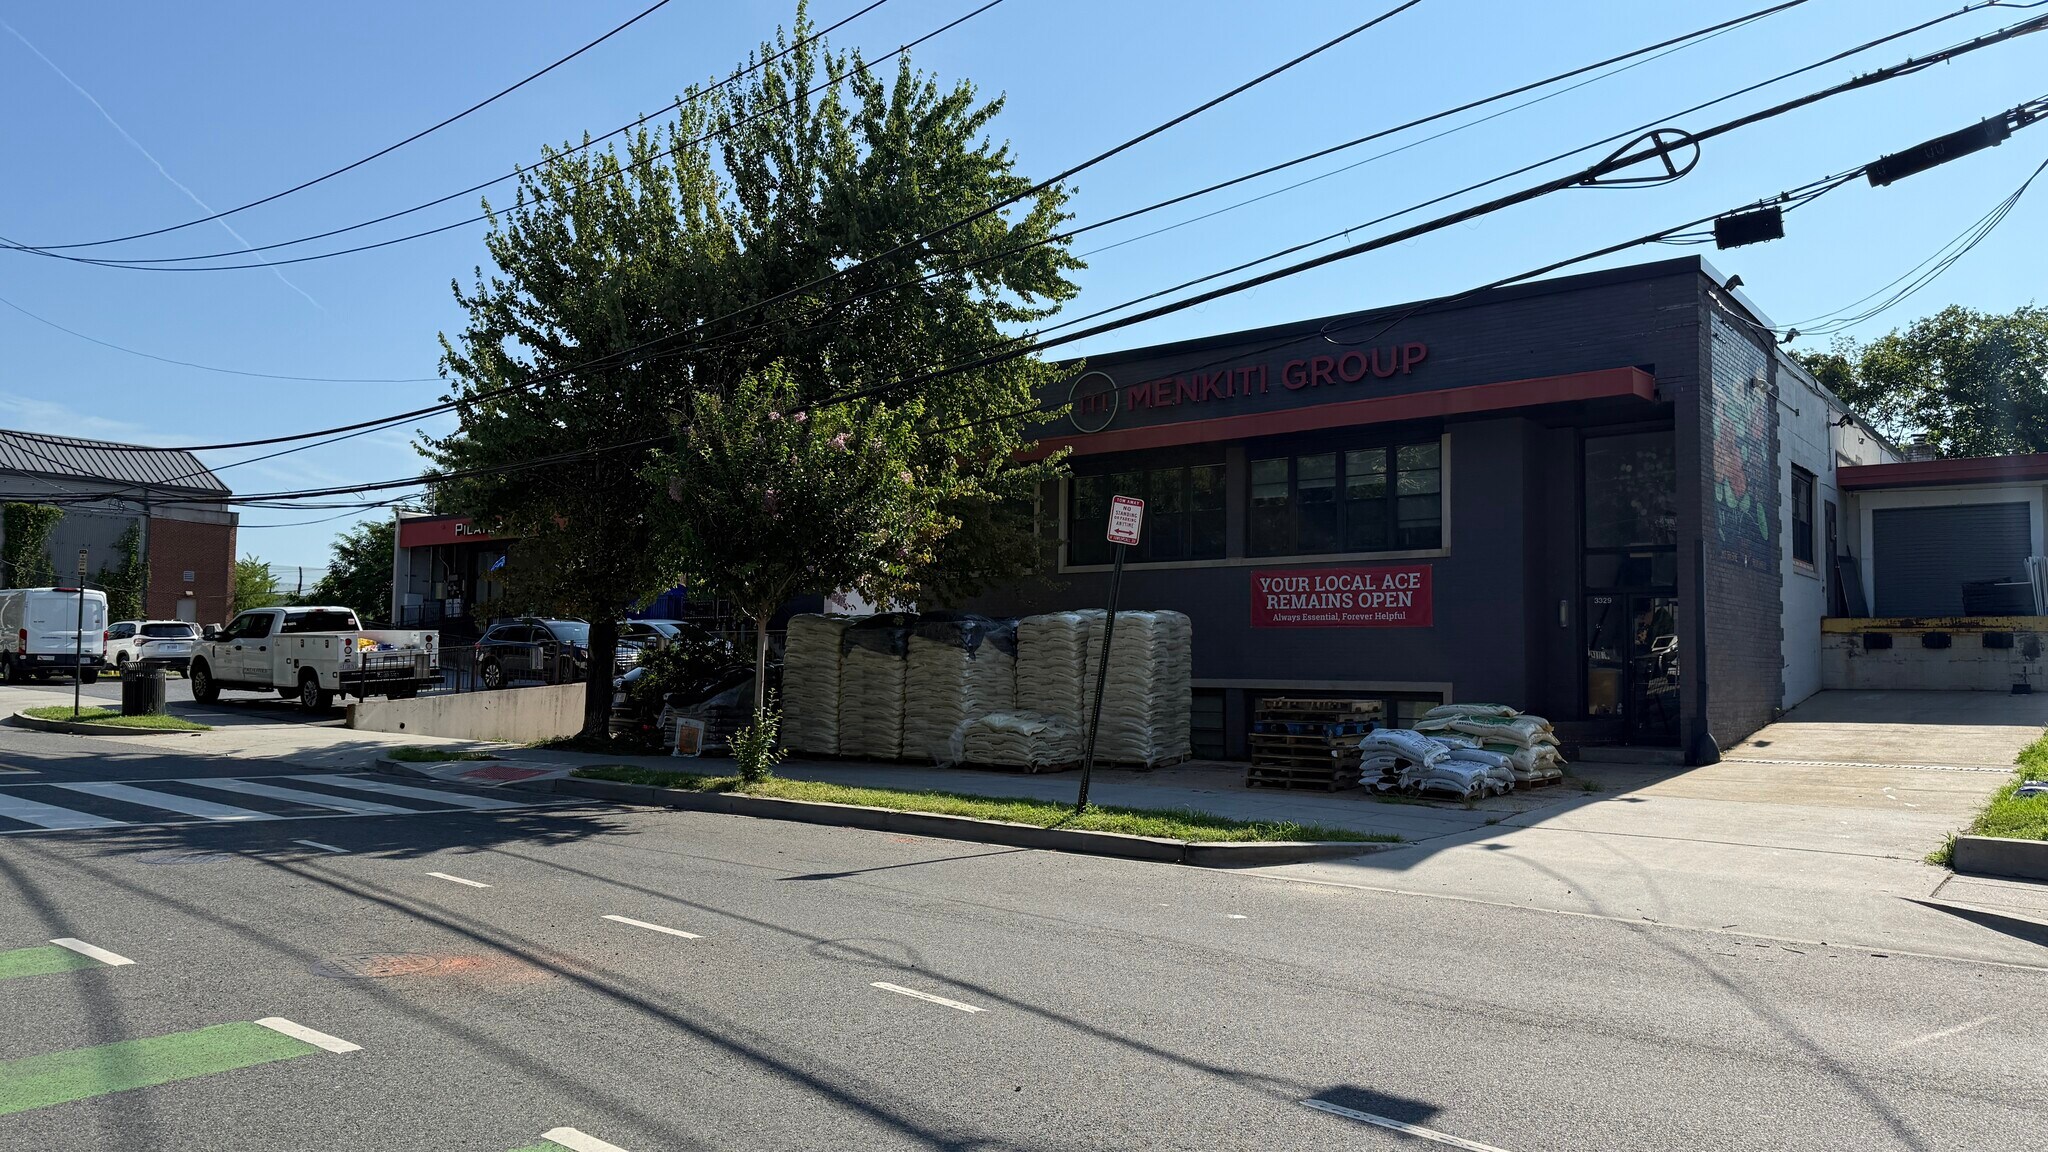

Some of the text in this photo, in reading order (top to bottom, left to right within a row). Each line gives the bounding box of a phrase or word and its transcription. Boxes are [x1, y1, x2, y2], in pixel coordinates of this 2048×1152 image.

[1127, 341, 1428, 411] MENKITI GROUP
[1259, 572, 1421, 593] YOUR LOCAL ACE
[1266, 591, 1413, 610] REMAINS OPEN
[1273, 611, 1406, 622] Always Essential, Forever Helpful
